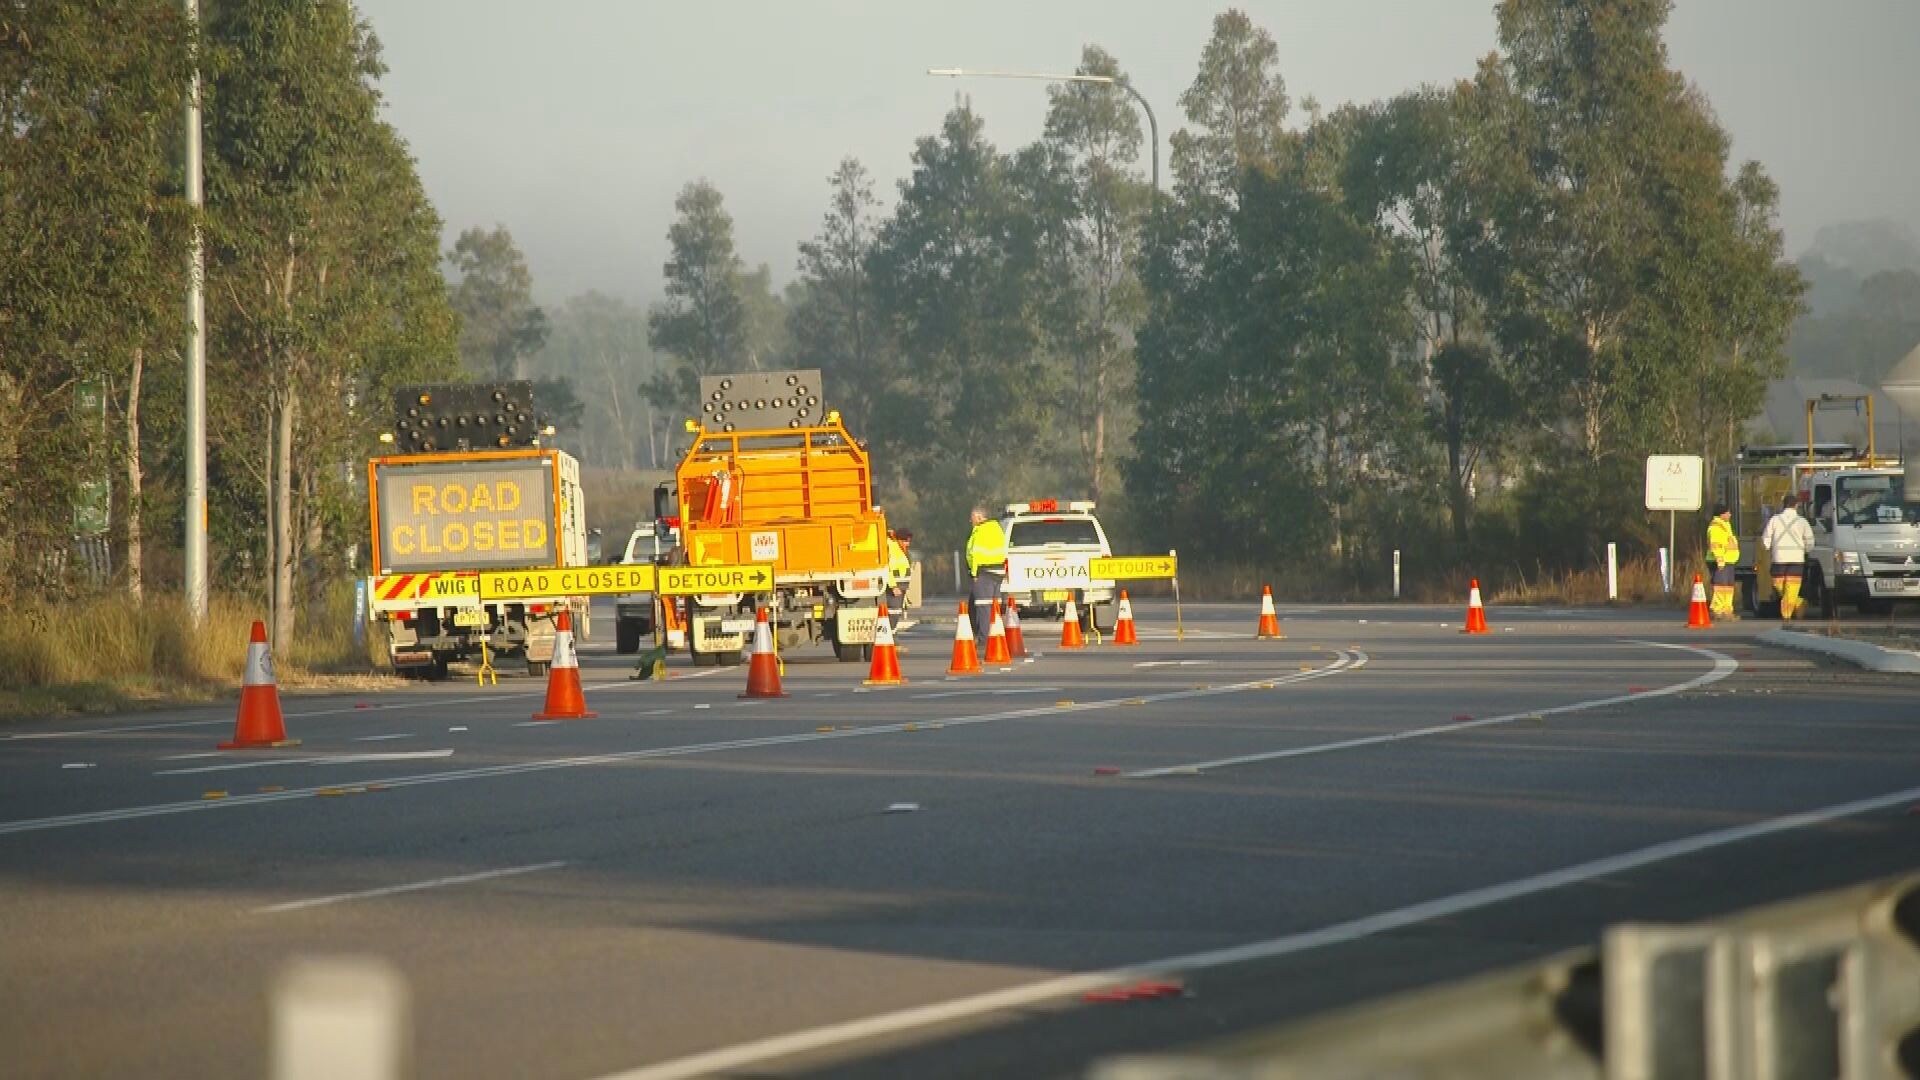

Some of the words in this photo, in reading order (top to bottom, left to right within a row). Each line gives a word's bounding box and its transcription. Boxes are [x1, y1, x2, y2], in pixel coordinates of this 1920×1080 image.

[412, 481, 521, 515] ROAD
[391, 519, 547, 555] CLOSED
[1024, 566, 1088, 579] TOYOTA
[1098, 562, 1154, 574] DETOUR
[435, 579, 465, 595] WIG
[494, 575, 549, 592] ROAD
[562, 570, 641, 590] CLOSED
[669, 573, 743, 589] DETOUR
